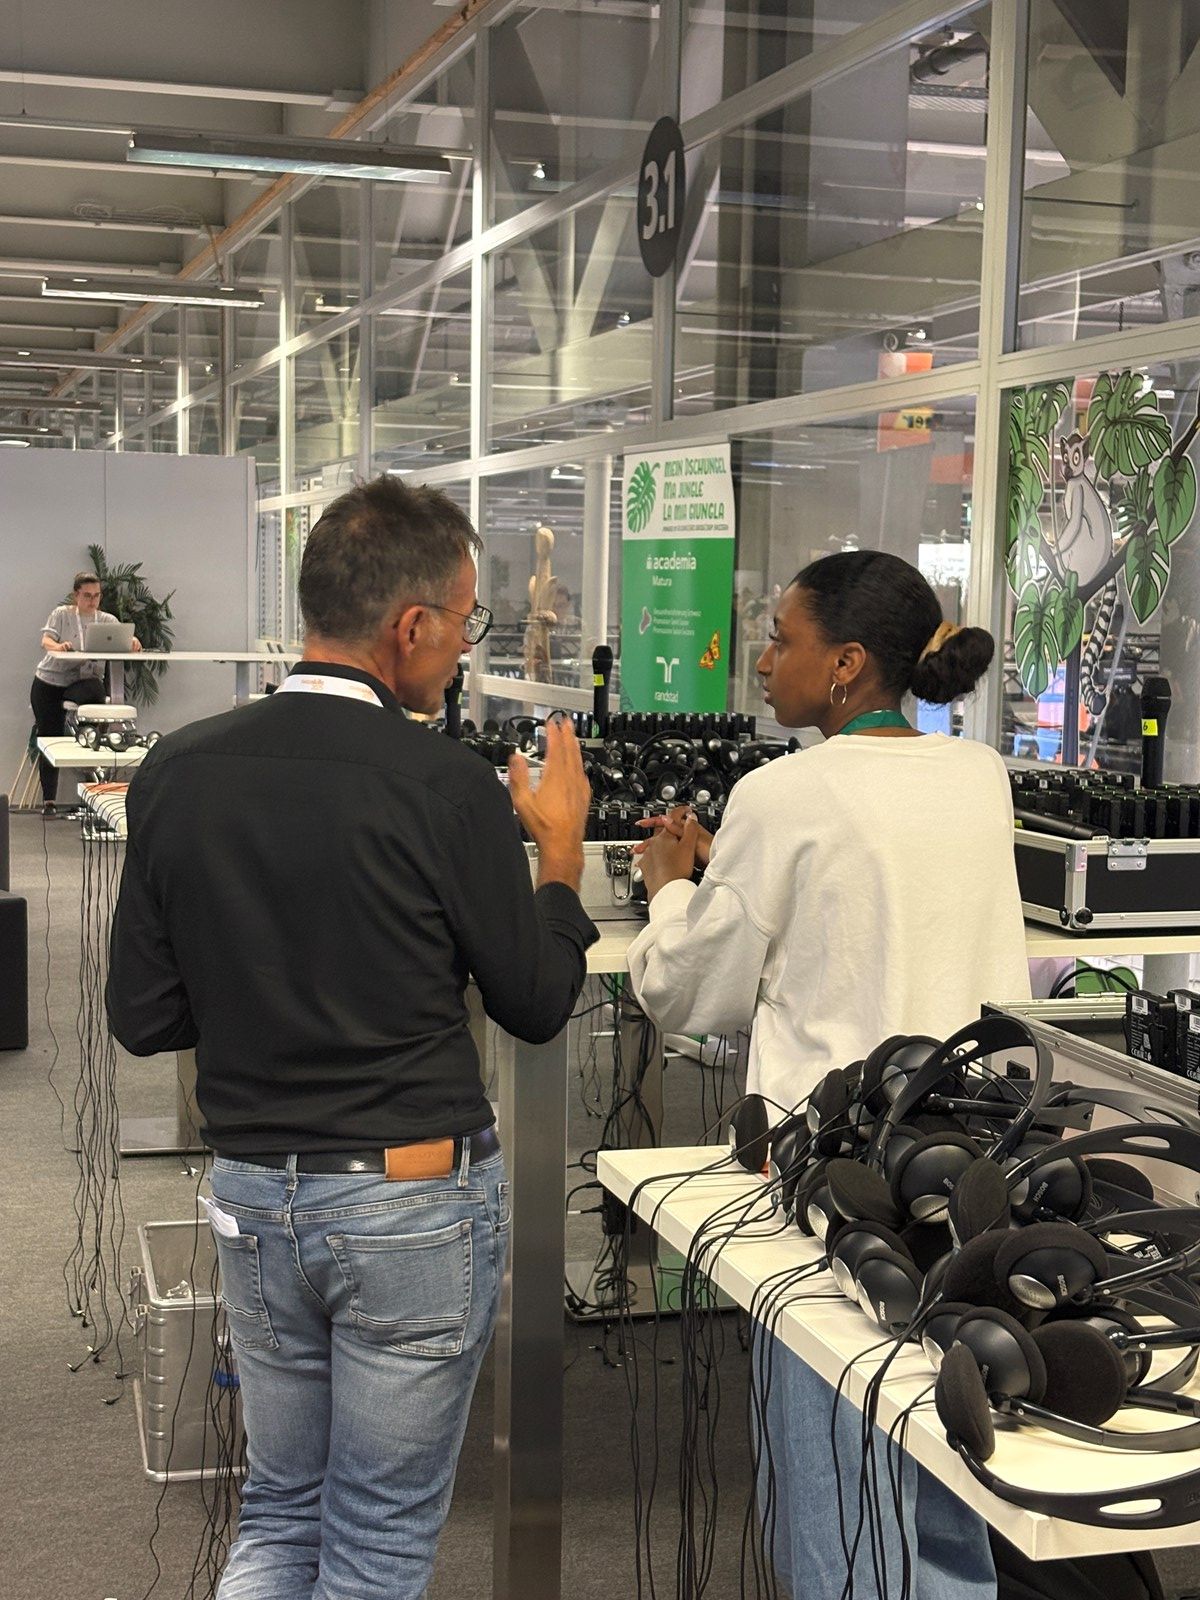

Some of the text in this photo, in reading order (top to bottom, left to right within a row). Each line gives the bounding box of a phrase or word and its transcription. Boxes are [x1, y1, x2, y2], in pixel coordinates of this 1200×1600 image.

[643, 151, 675, 240] 3.1
[664, 457, 726, 477] MEIN DSCHUNGEL
[663, 481, 704, 499] MA JUNGLE
[663, 503, 672, 521] LA
[689, 502, 725, 520] GIUNGLA
[653, 551, 697, 570] academia
[652, 575, 673, 586] Matura
[1032, 1181, 1049, 1202] BOSCH
